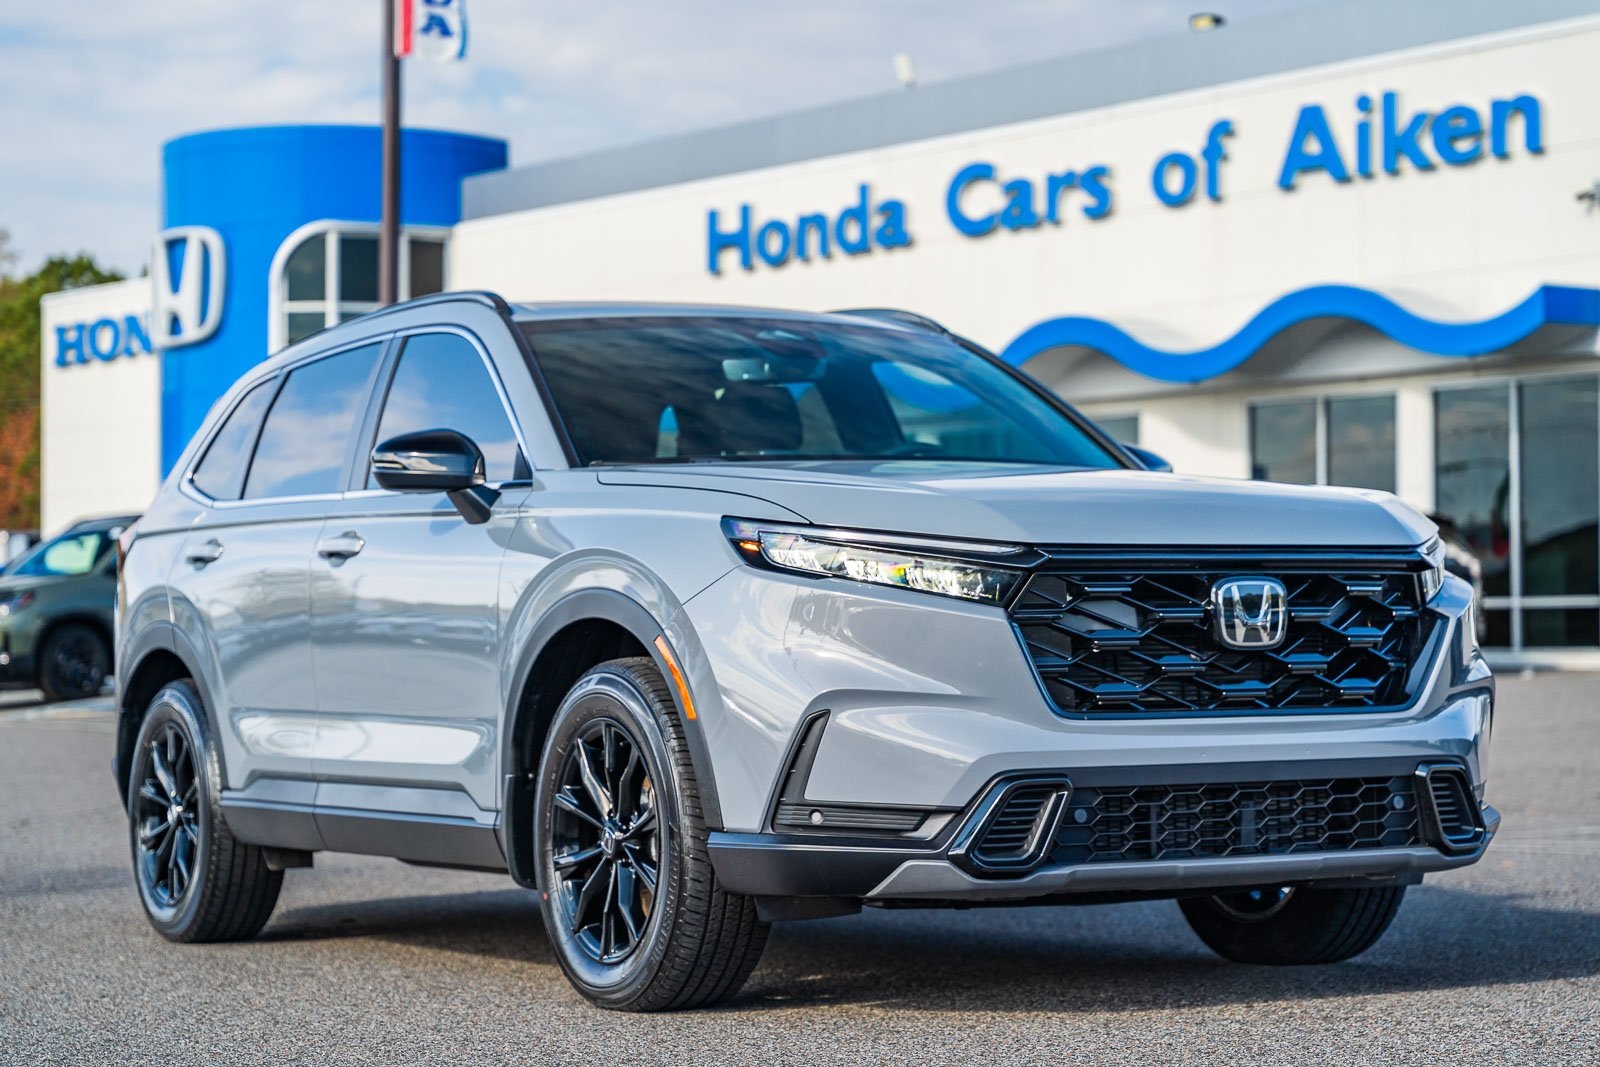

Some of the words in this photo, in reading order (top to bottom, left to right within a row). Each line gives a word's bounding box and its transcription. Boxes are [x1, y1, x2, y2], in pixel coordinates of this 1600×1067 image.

[707, 182, 911, 275] Honda
[945, 161, 1112, 238] Cars
[1152, 118, 1234, 207] of
[1276, 91, 1546, 190] Aiken
